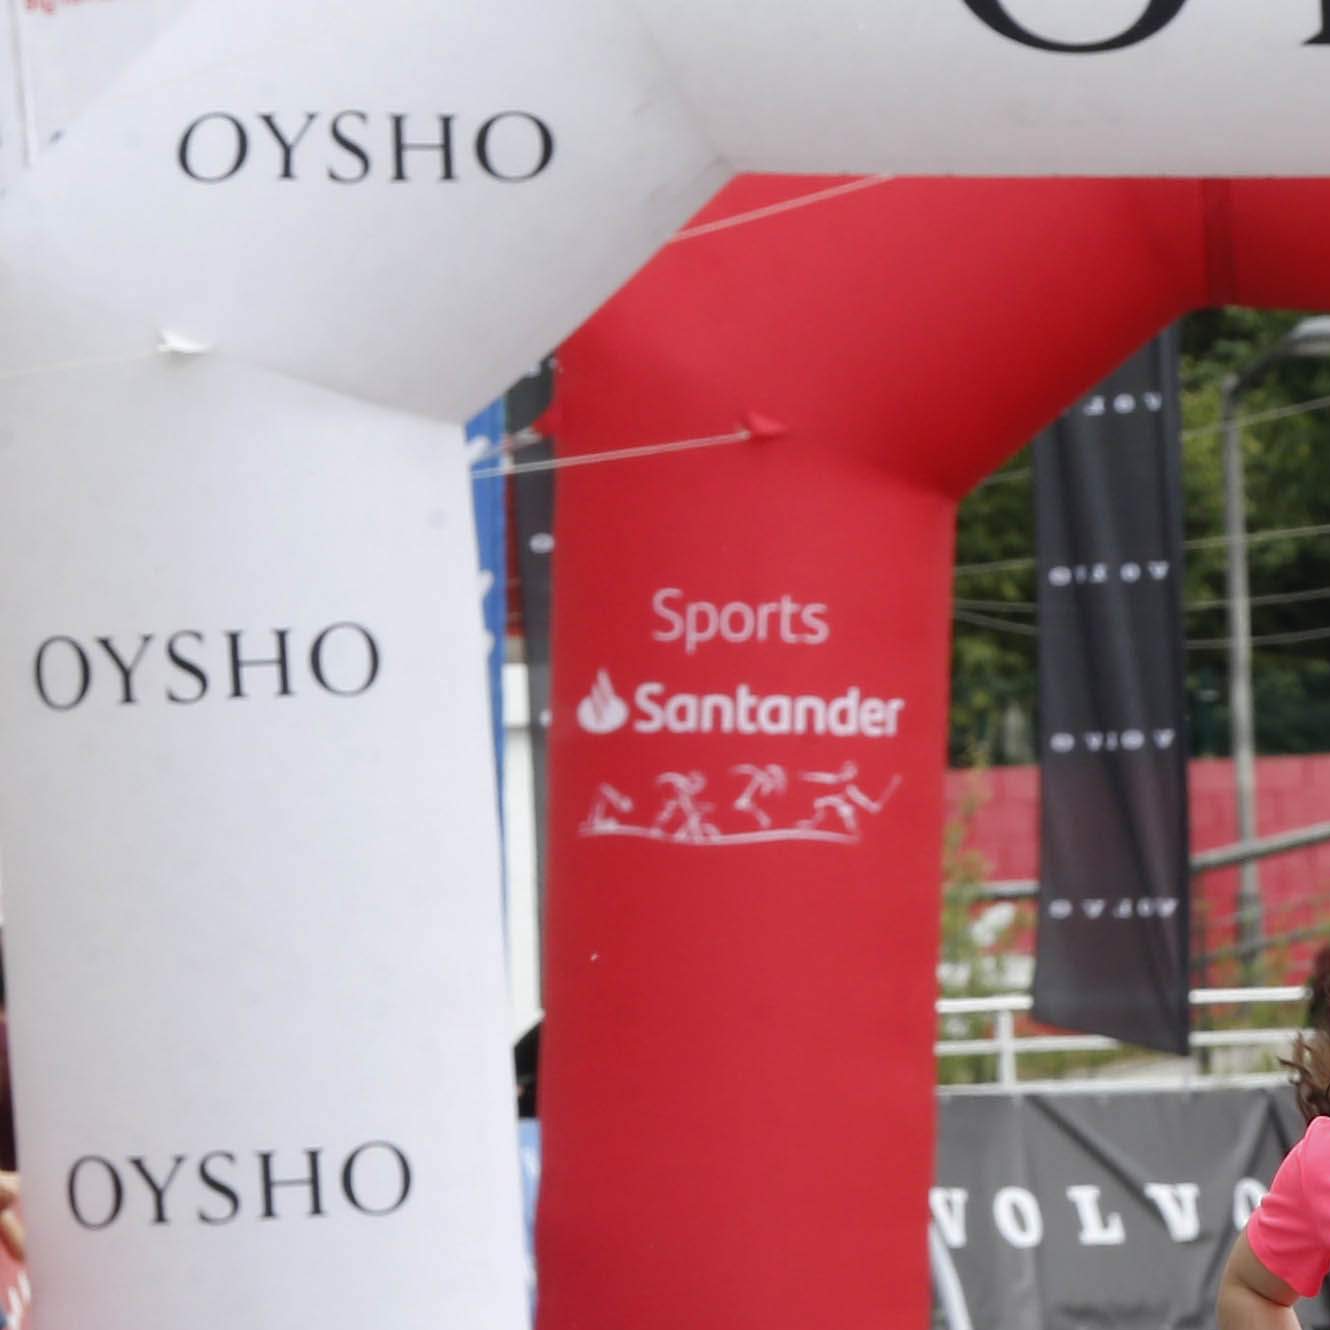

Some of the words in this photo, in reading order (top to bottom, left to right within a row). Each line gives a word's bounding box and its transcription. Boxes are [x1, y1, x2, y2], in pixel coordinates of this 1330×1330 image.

[177, 110, 556, 184] OYSHO
[652, 587, 830, 654] Sports
[33, 621, 381, 710] OYSHO
[634, 682, 904, 737] Santander
[66, 1140, 412, 1230] OYSHO
